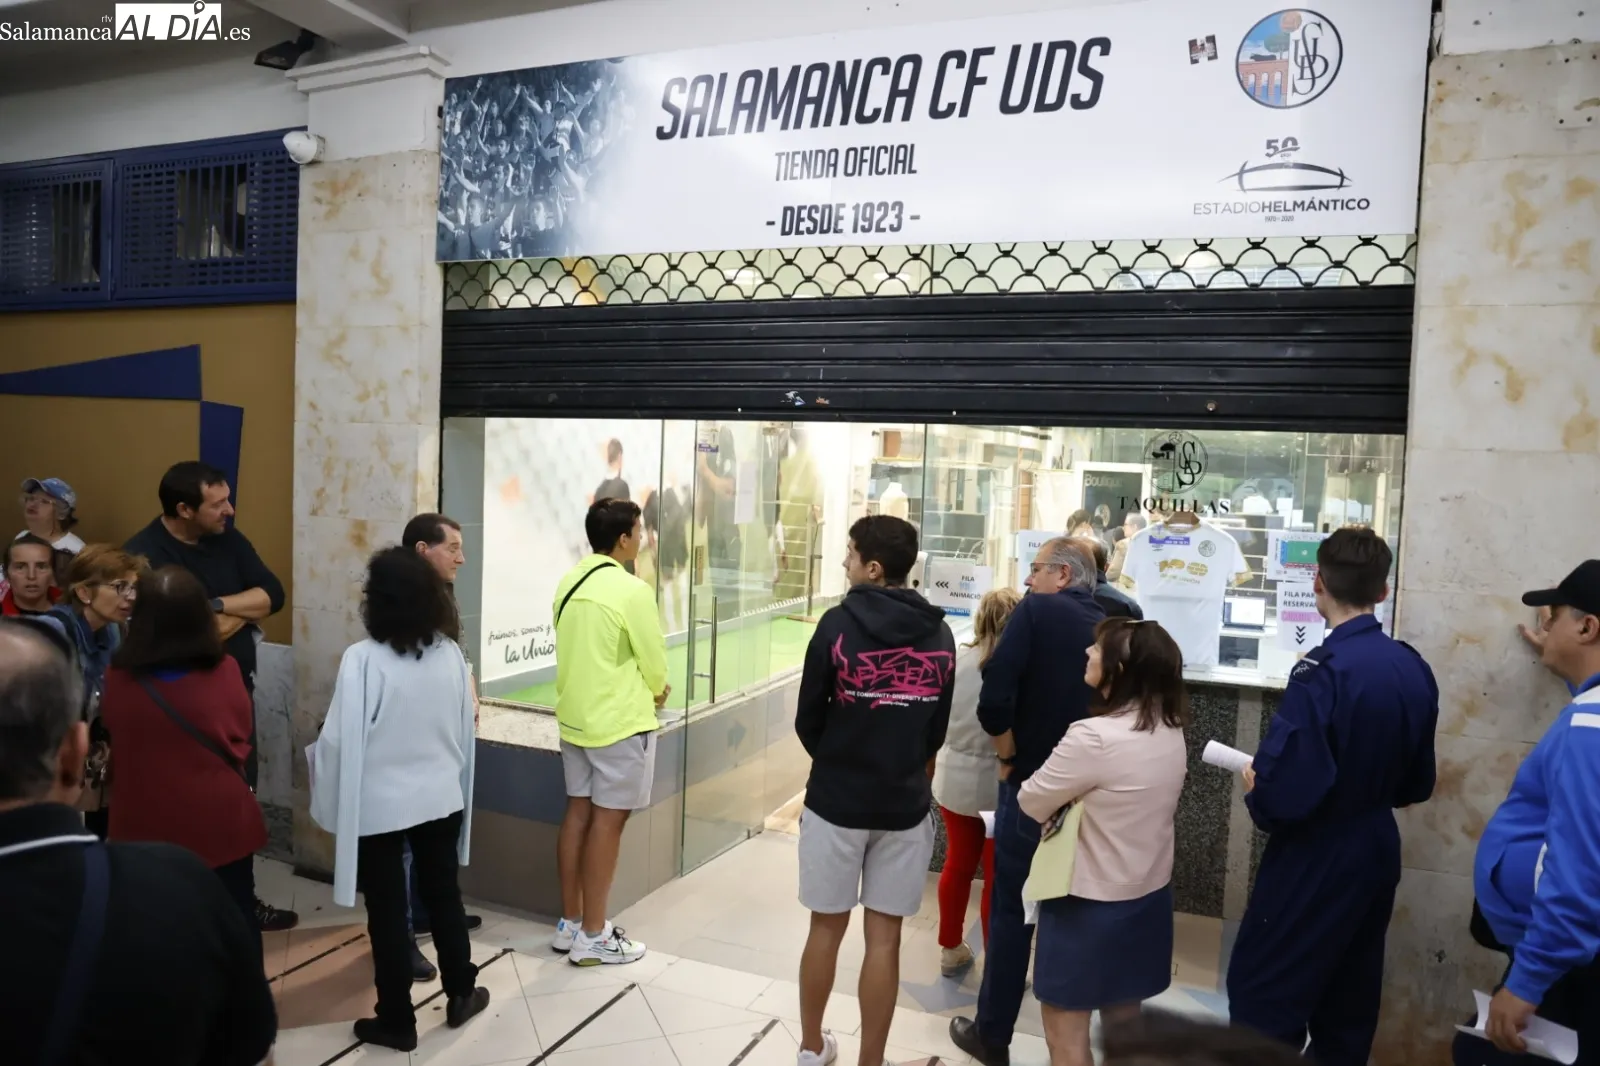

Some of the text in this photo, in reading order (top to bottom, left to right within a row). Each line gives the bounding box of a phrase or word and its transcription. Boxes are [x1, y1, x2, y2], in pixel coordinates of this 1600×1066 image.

[655, 36, 1112, 141] SALAMANCA CF UDS
[1265, 136, 1300, 158] 50
[774, 143, 918, 182] TIENDA OFICIAL
[780, 203, 847, 236] DESDE
[851, 200, 904, 234] 1923
[1117, 495, 1230, 514] TAQUILLAS
[1284, 590, 1300, 598] FILA
[521, 624, 544, 636] somos
[505, 644, 520, 664] la
